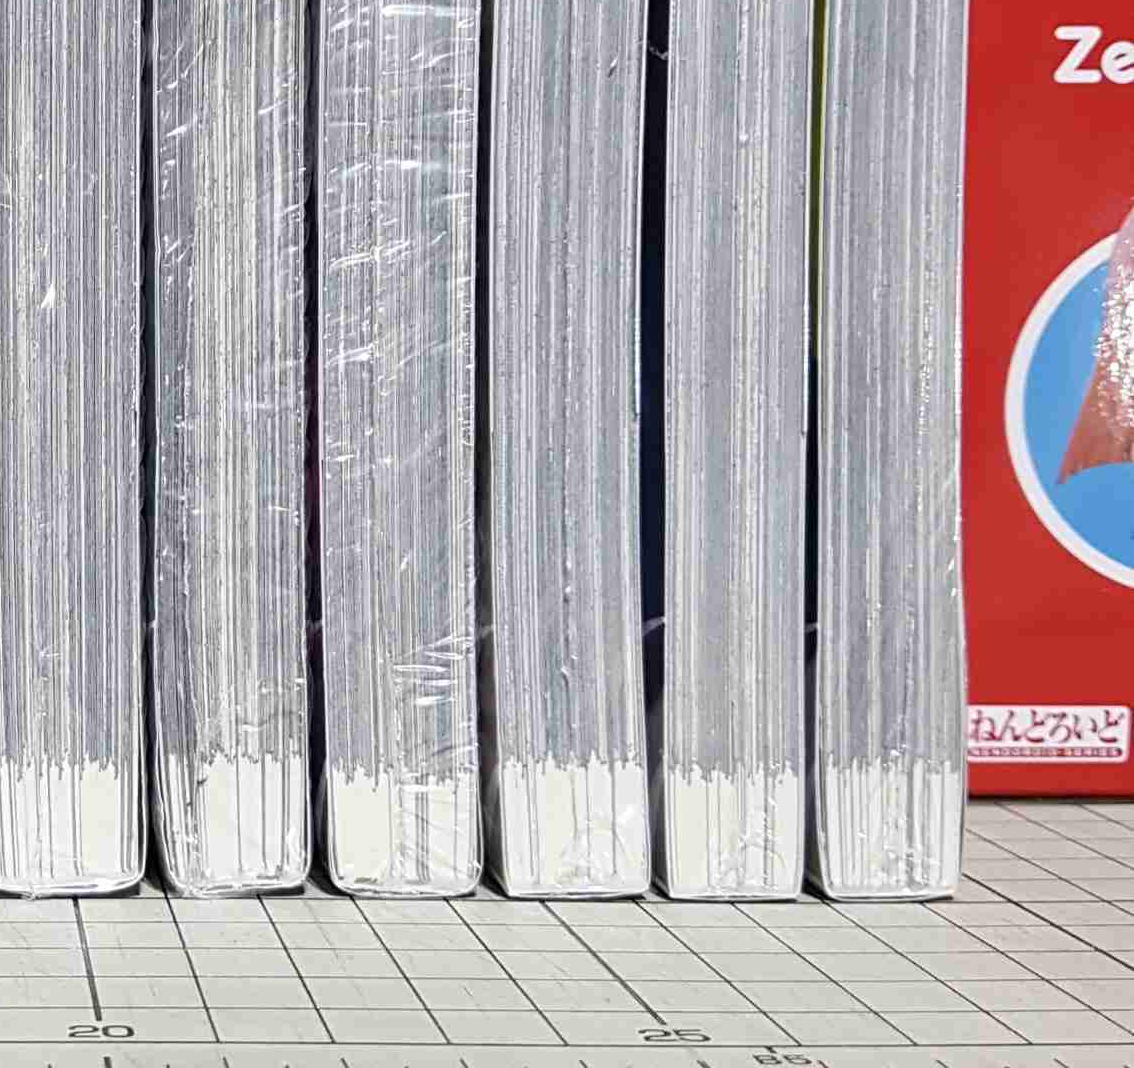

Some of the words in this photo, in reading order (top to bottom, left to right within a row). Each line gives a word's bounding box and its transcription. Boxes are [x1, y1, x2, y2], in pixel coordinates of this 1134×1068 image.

[1053, 25, 1134, 84] Ze
[969, 709, 1125, 743] ねんどろいど
[68, 1025, 134, 1038] 20
[638, 1029, 711, 1042] 25
[752, 1054, 812, 1065] B5
